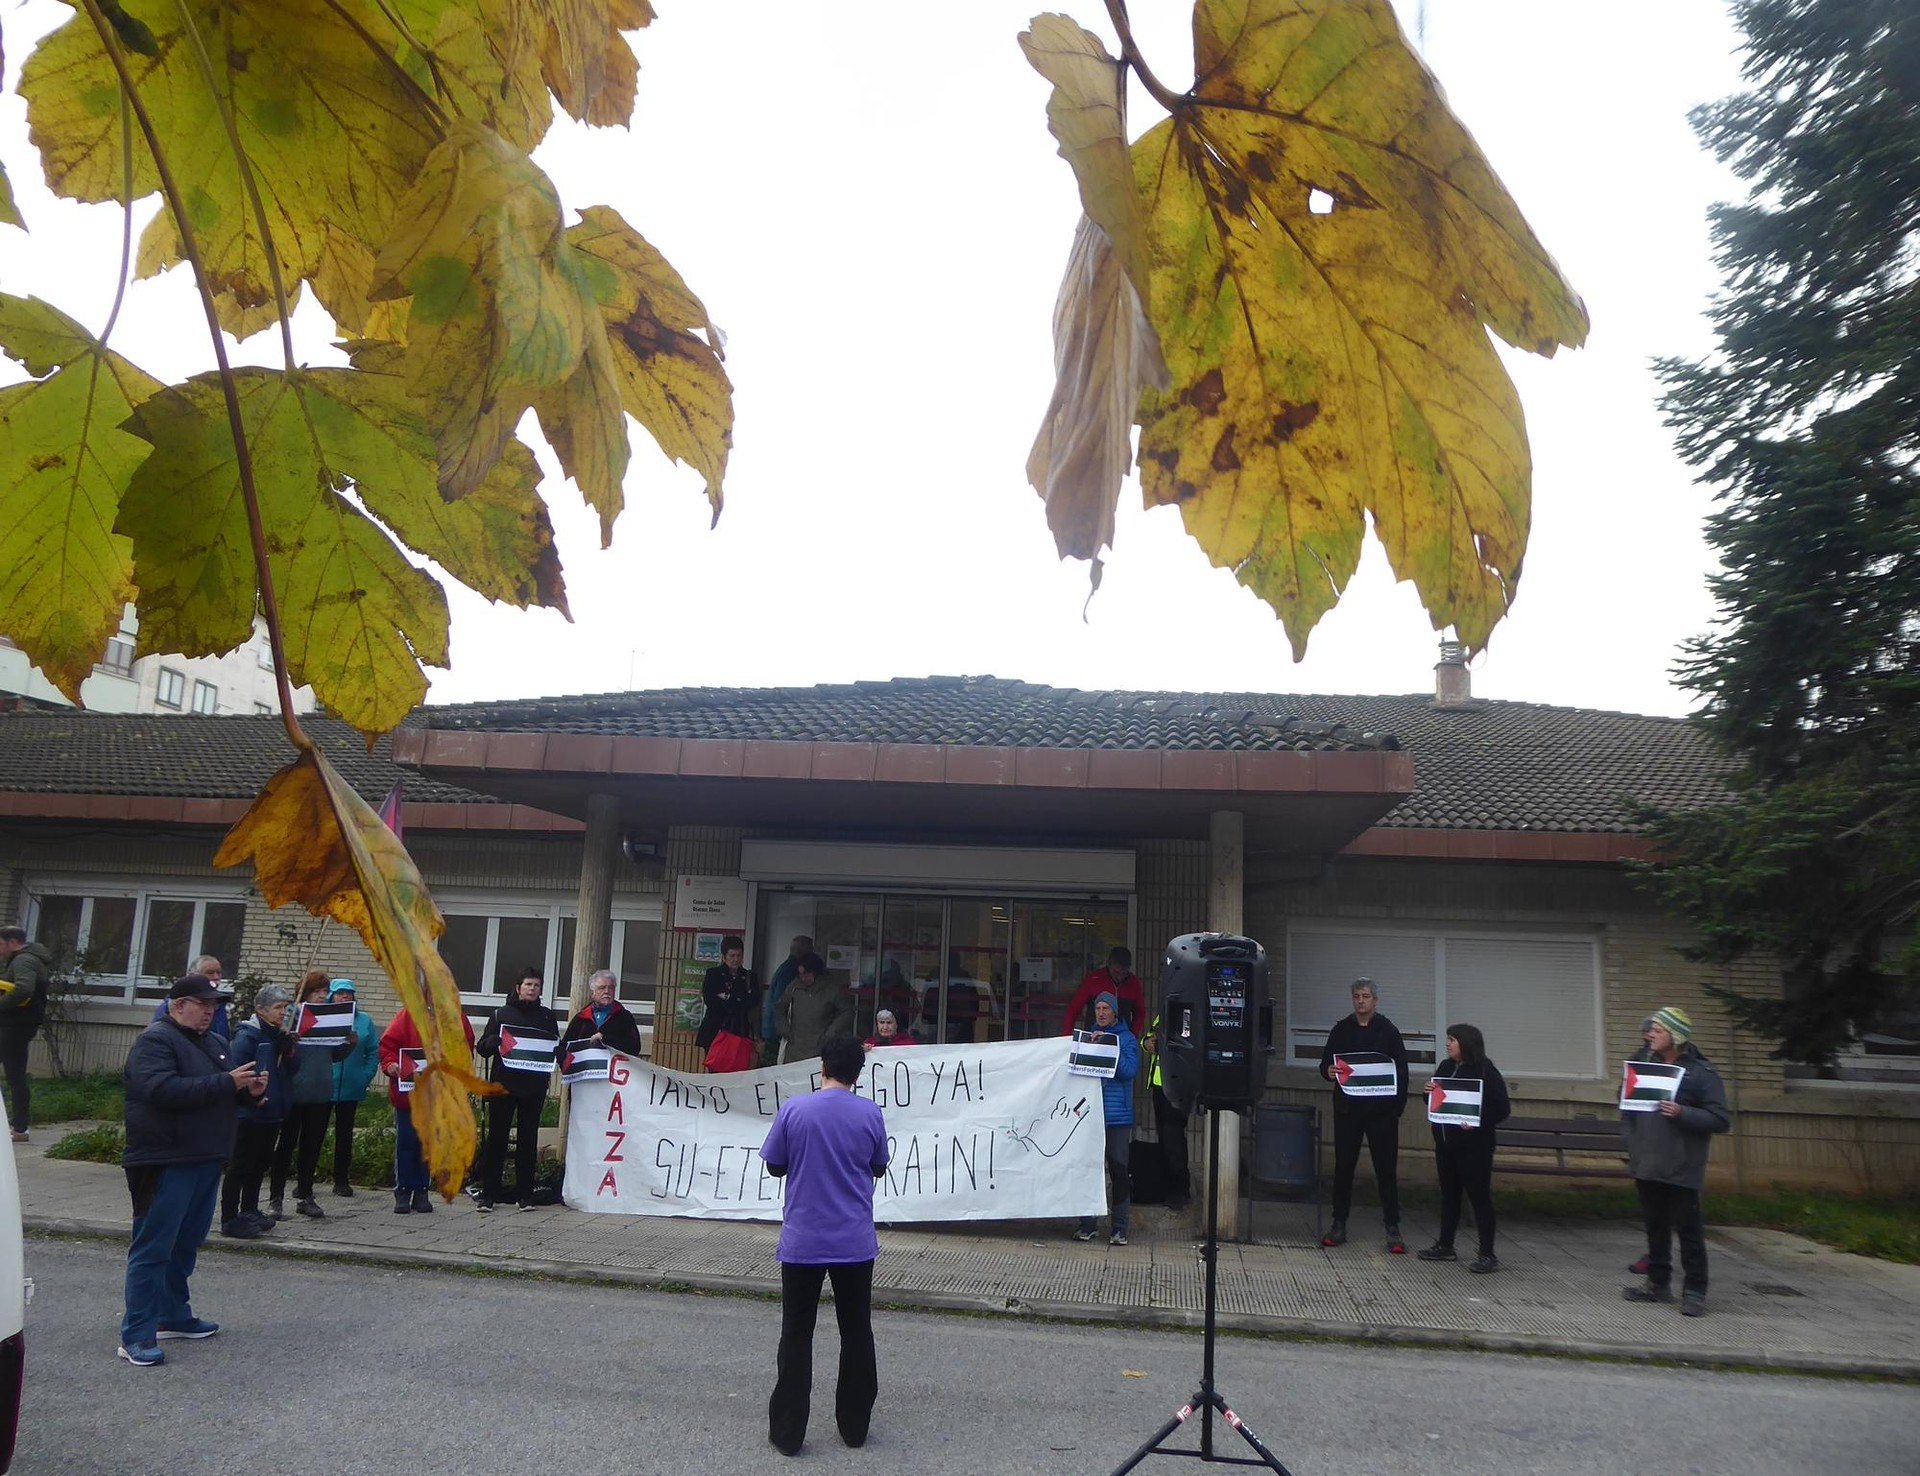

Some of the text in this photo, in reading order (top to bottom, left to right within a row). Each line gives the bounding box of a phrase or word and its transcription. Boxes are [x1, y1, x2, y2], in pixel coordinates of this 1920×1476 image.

[930, 1060, 984, 1106] YA!
[596, 1055, 630, 1197] GAZA
[650, 1138, 783, 1200] SU-ETE
